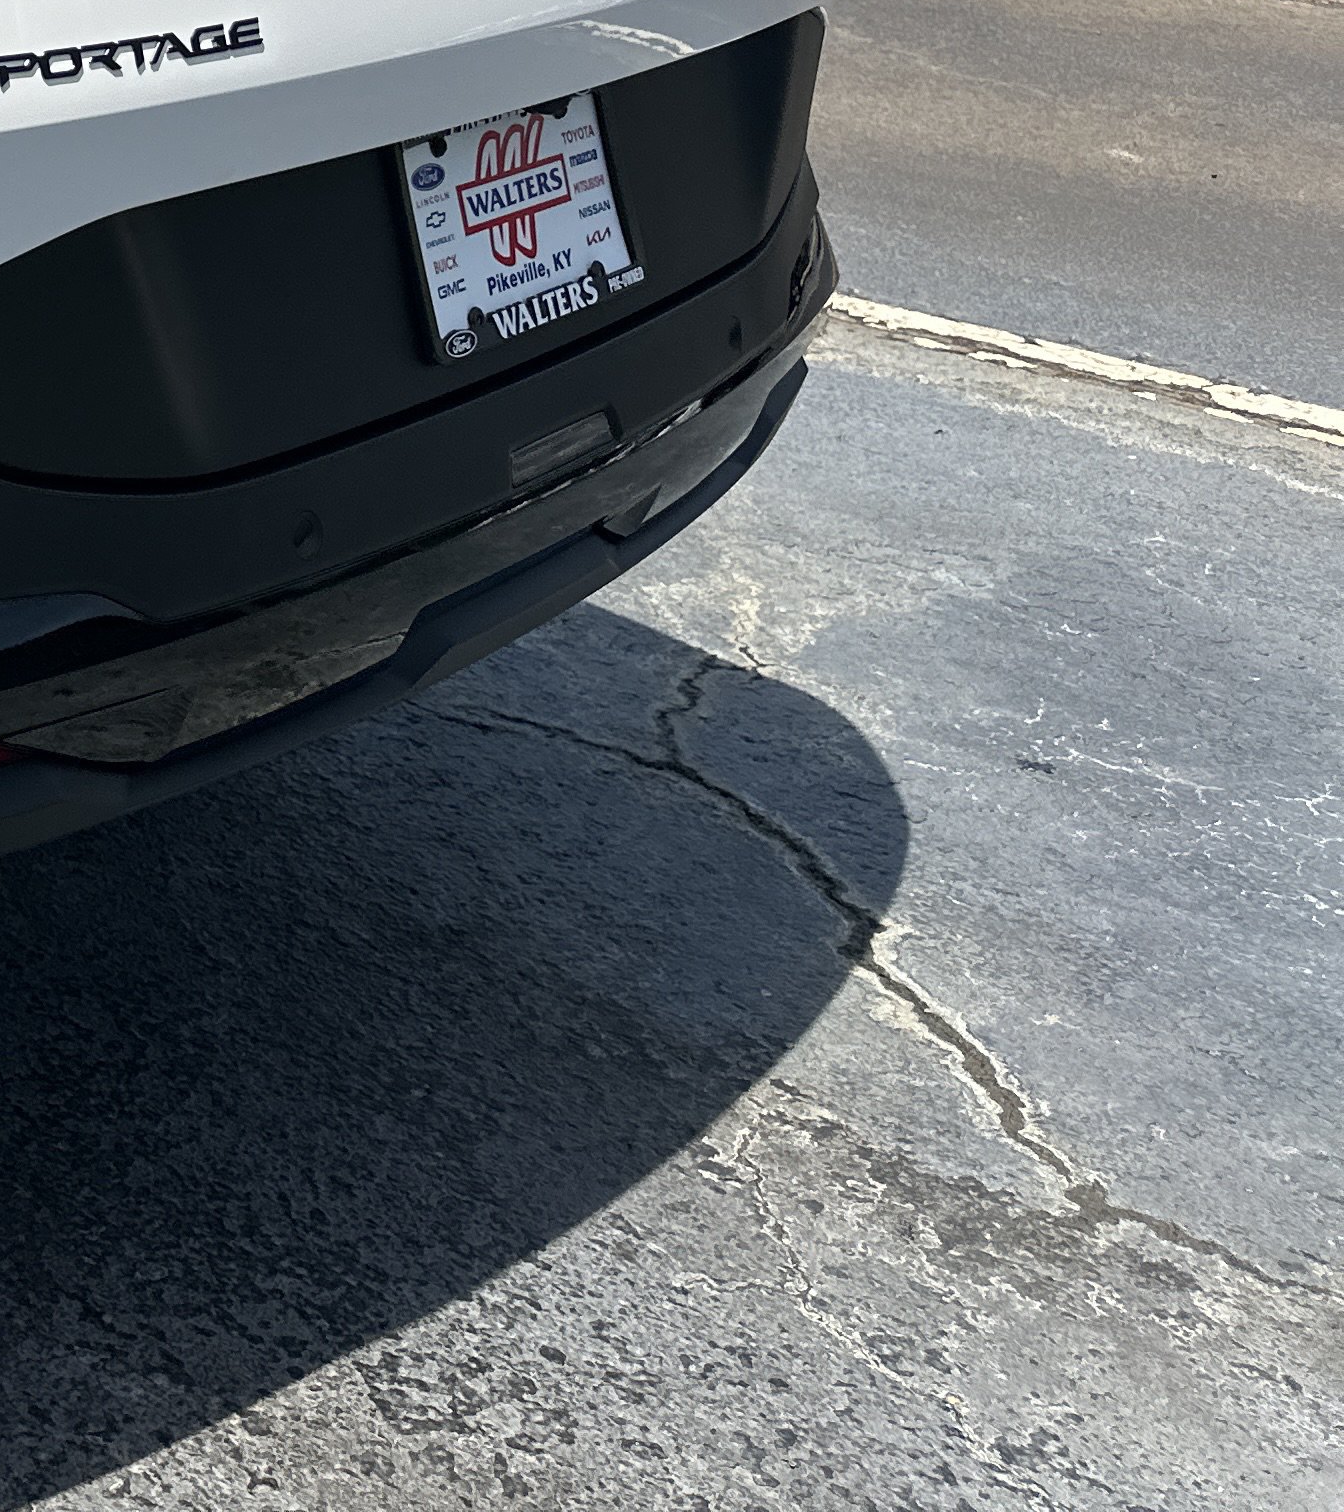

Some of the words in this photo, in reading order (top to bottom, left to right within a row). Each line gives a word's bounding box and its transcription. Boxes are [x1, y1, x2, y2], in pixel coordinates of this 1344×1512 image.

[561, 124, 595, 145] TOYOTA
[415, 191, 451, 209] LINCOLN
[466, 166, 563, 217] WALTERS
[578, 199, 611, 219] NISSAN
[433, 254, 459, 275] BUICK
[486, 259, 551, 296] Pikeville,
[552, 248, 573, 271] KY
[437, 278, 467, 300] GMC
[492, 276, 599, 339] WALTERS
